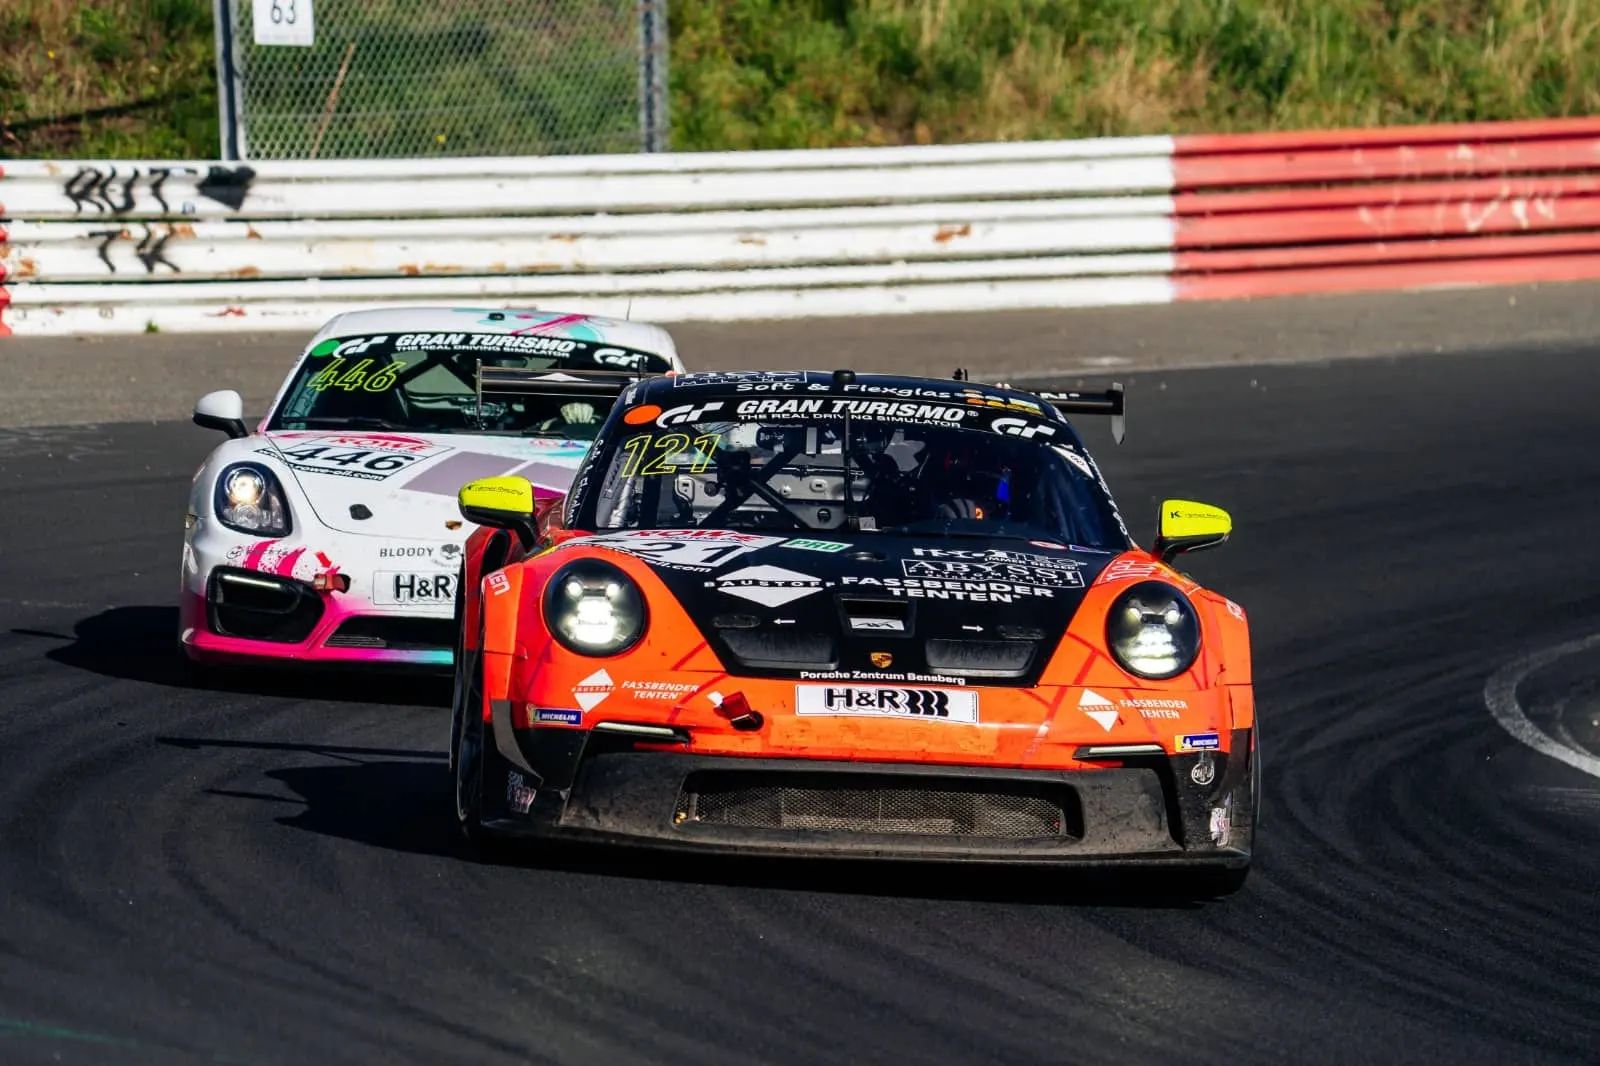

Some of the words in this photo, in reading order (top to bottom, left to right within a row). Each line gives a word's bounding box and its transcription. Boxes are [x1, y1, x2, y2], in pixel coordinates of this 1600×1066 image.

[271, 0, 296, 24] 63
[395, 333, 466, 347] GRAN
[453, 344, 501, 352] DRIVING
[503, 346, 570, 358] SIMULATOR
[307, 358, 407, 392] 446
[736, 382, 795, 391] Soft
[807, 383, 830, 391] &
[736, 399, 824, 414] GRAN
[812, 413, 873, 421] DRIVNG
[876, 415, 961, 428] SIMULATOR
[284, 447, 415, 471] 446
[621, 432, 723, 478] 121
[379, 547, 434, 558] BLOODY
[788, 540, 845, 551] PRO
[908, 560, 1077, 581] ABYSSI
[394, 574, 452, 599] H&R
[704, 578, 836, 588] BAUSTOFF
[842, 576, 1055, 598] FASSBENDER
[621, 680, 699, 692] FASSBENDER
[800, 671, 850, 680] Porsche
[852, 671, 904, 681] Zentrum
[907, 672, 966, 686] Bensberg
[633, 690, 678, 700] TENTEN
[826, 687, 902, 710] H&R
[1120, 699, 1188, 710] FASSBENDER
[1139, 708, 1180, 719] TENTEN
